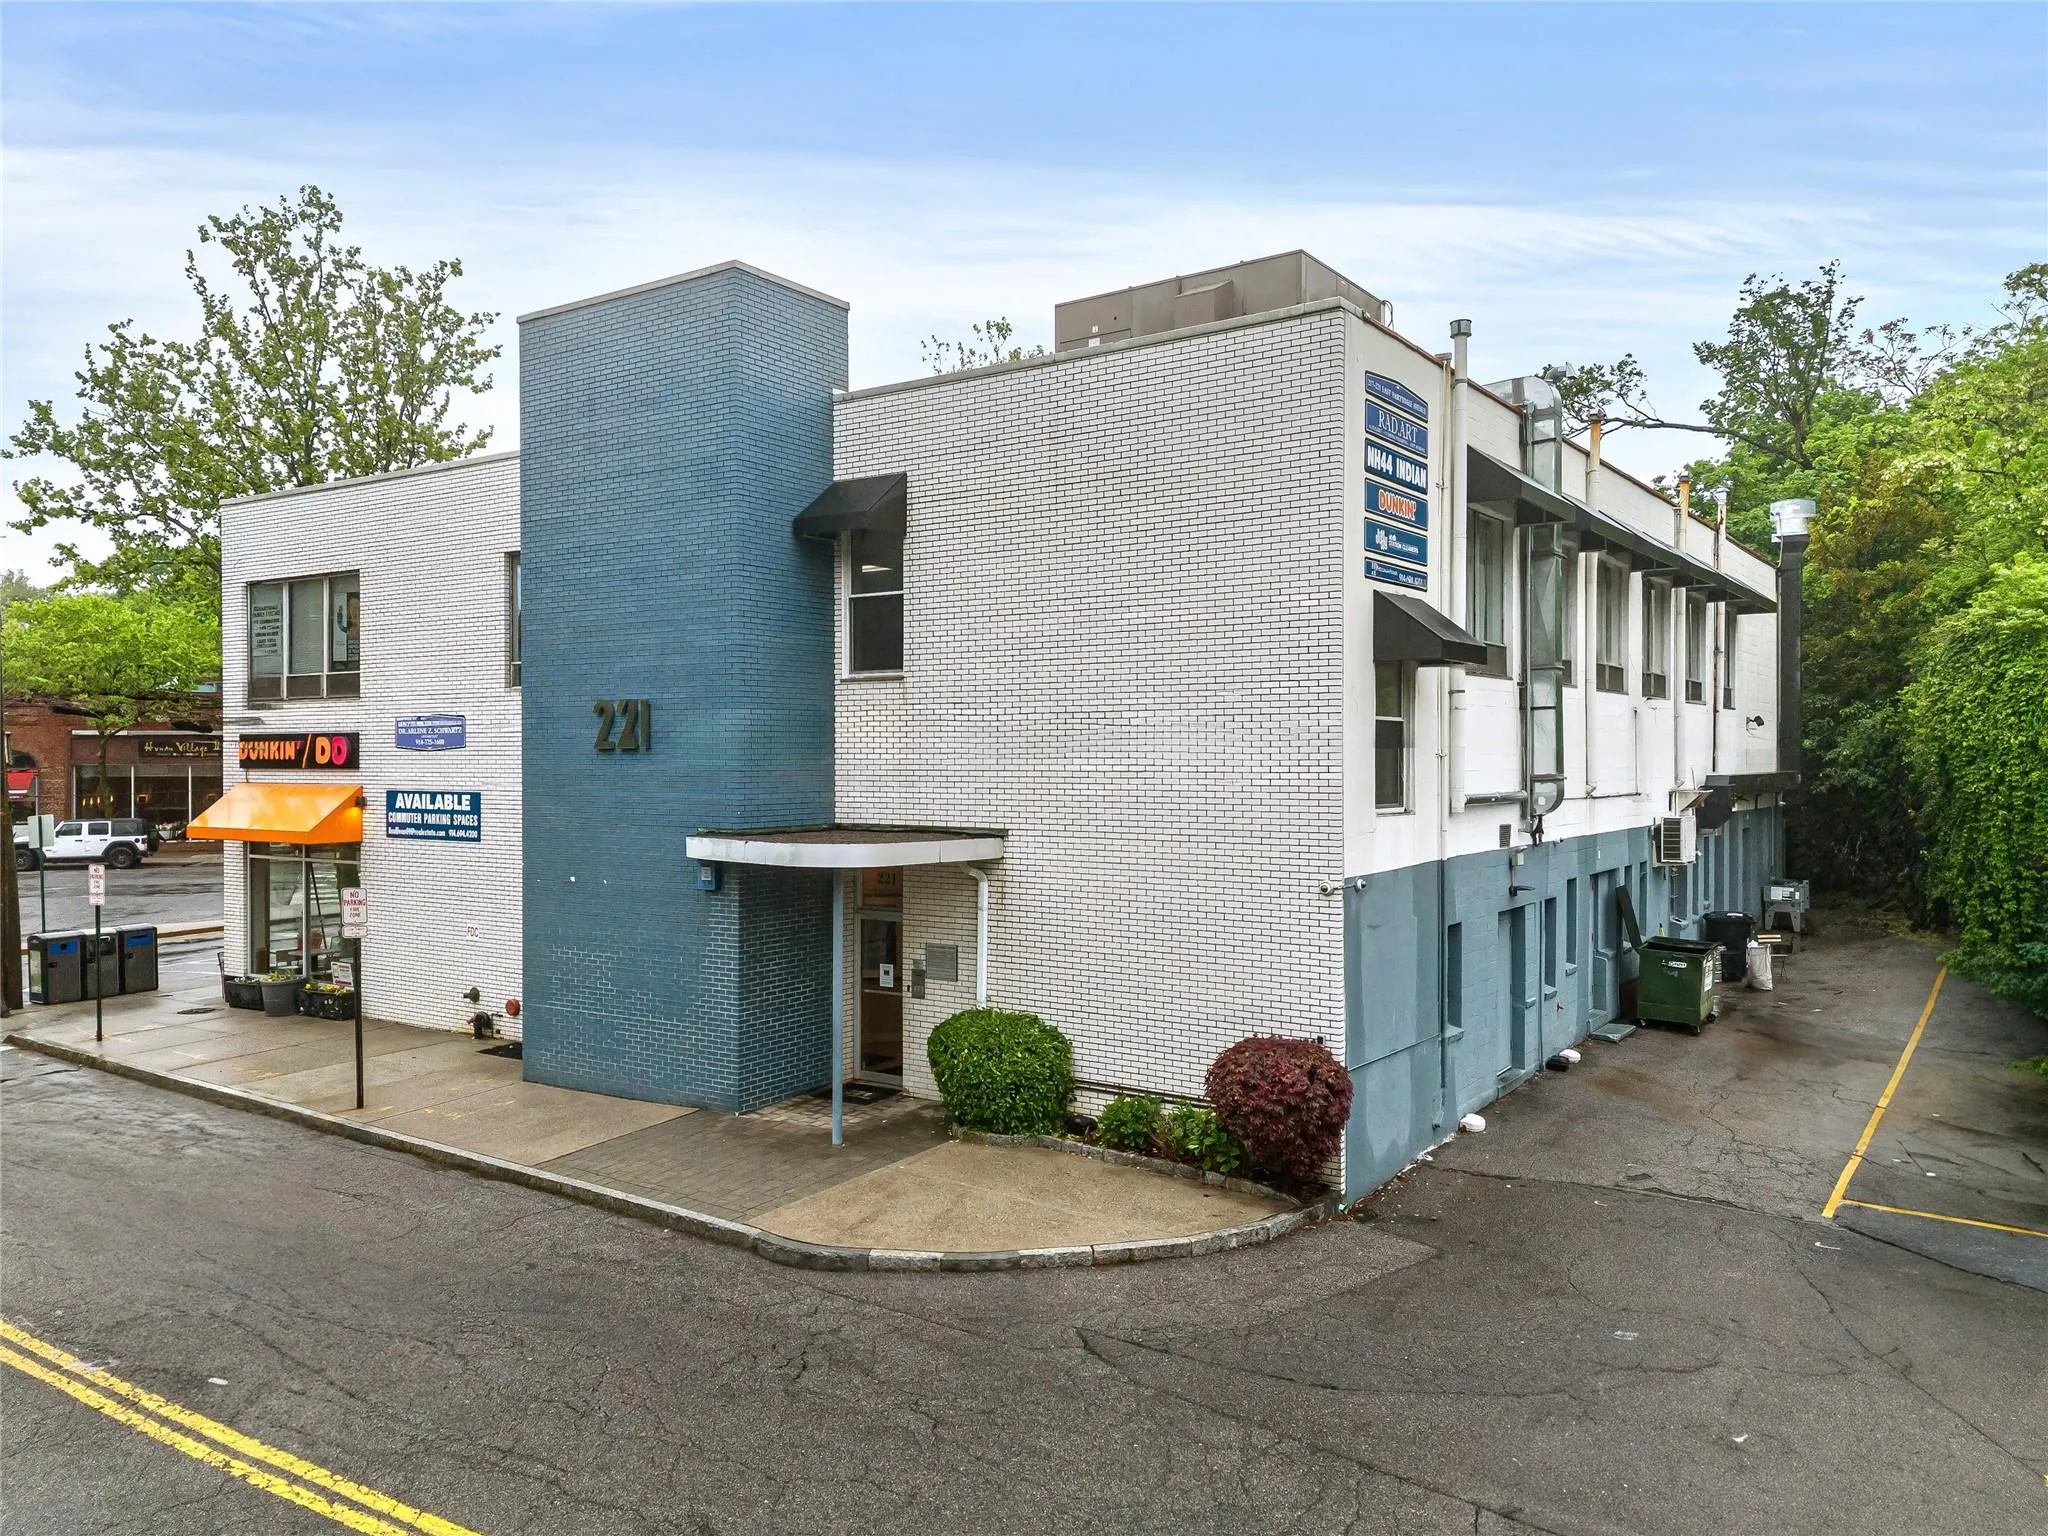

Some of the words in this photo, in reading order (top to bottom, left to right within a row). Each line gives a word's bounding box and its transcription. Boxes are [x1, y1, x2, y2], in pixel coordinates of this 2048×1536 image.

[1368, 445, 1393, 475] NH44
[1396, 458, 1426, 489] INDIAN
[592, 698, 651, 752] 221
[176, 742, 208, 757] Village
[395, 792, 471, 811] AVAILABLE
[388, 812, 422, 824] COMMUTER
[424, 812, 450, 825] PARKING
[453, 814, 478, 826] SPACES
[877, 871, 896, 884] 221
[467, 926, 479, 938] FDC
